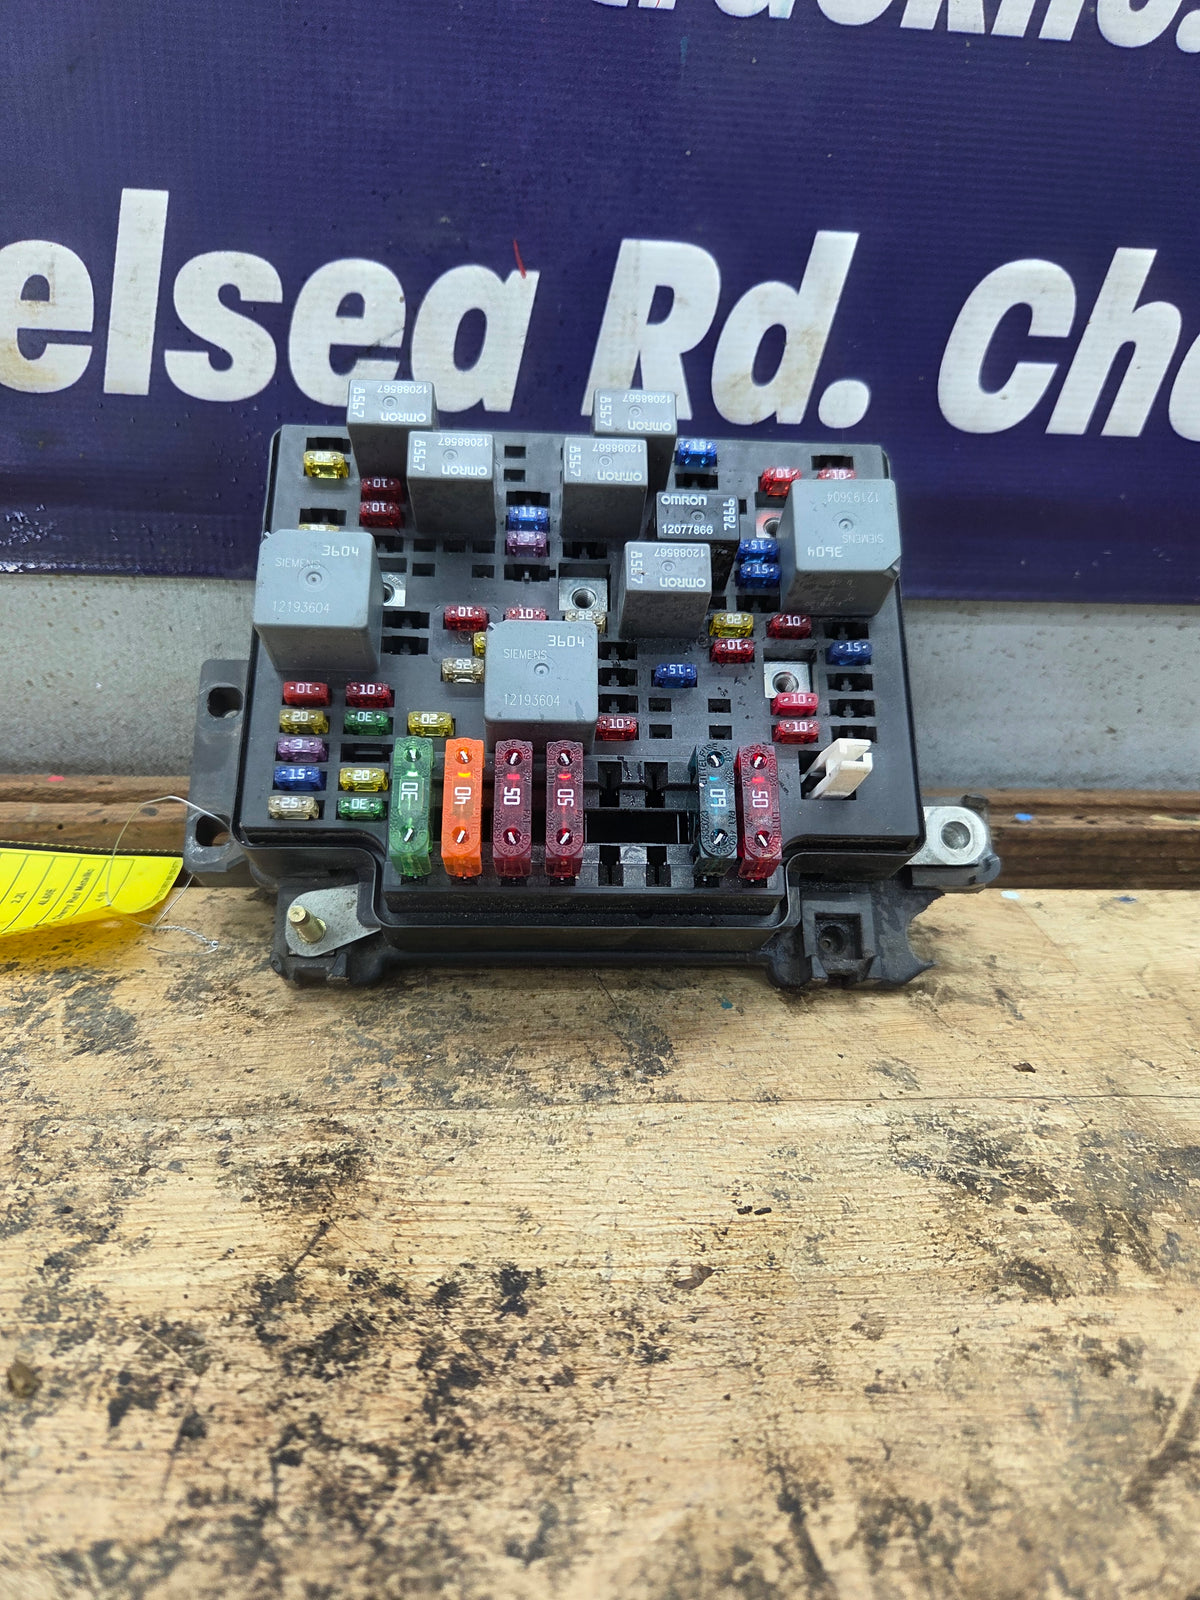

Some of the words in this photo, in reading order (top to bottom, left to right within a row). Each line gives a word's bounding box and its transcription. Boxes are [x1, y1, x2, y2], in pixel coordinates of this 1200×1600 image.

[0, 188, 540, 412] elsea
[581, 229, 870, 430] Rd.
[378, 384, 428, 394] 12088567
[352, 387, 366, 418] 8567
[622, 394, 672, 404] 12088567
[600, 396, 612, 427] 8567
[438, 437, 489, 447] 12088567
[592, 443, 642, 453] 12088567
[413, 440, 427, 471] 8567
[569, 446, 582, 477] 8567
[723, 498, 736, 531] 7866
[662, 524, 714, 535] 12077866
[842, 534, 885, 544] SIEMENS
[321, 545, 359, 557] 3604
[654, 548, 706, 558] 12088567
[807, 546, 843, 558] 3604
[275, 557, 321, 569] SIEMENS
[630, 551, 644, 584] 8567
[273, 601, 330, 614] 12193604
[785, 615, 801, 626] 10
[548, 635, 585, 647] 3604
[846, 642, 861, 652] 15
[503, 649, 548, 661] SIEMENS
[360, 684, 376, 695] 10
[504, 693, 561, 707] 12193604
[791, 694, 806, 705] 10
[609, 718, 625, 729] 10
[793, 721, 808, 732] 10
[289, 768, 306, 780] 15
[353, 770, 370, 781] 20
[503, 786, 521, 806] 50
[752, 790, 769, 808] 50
